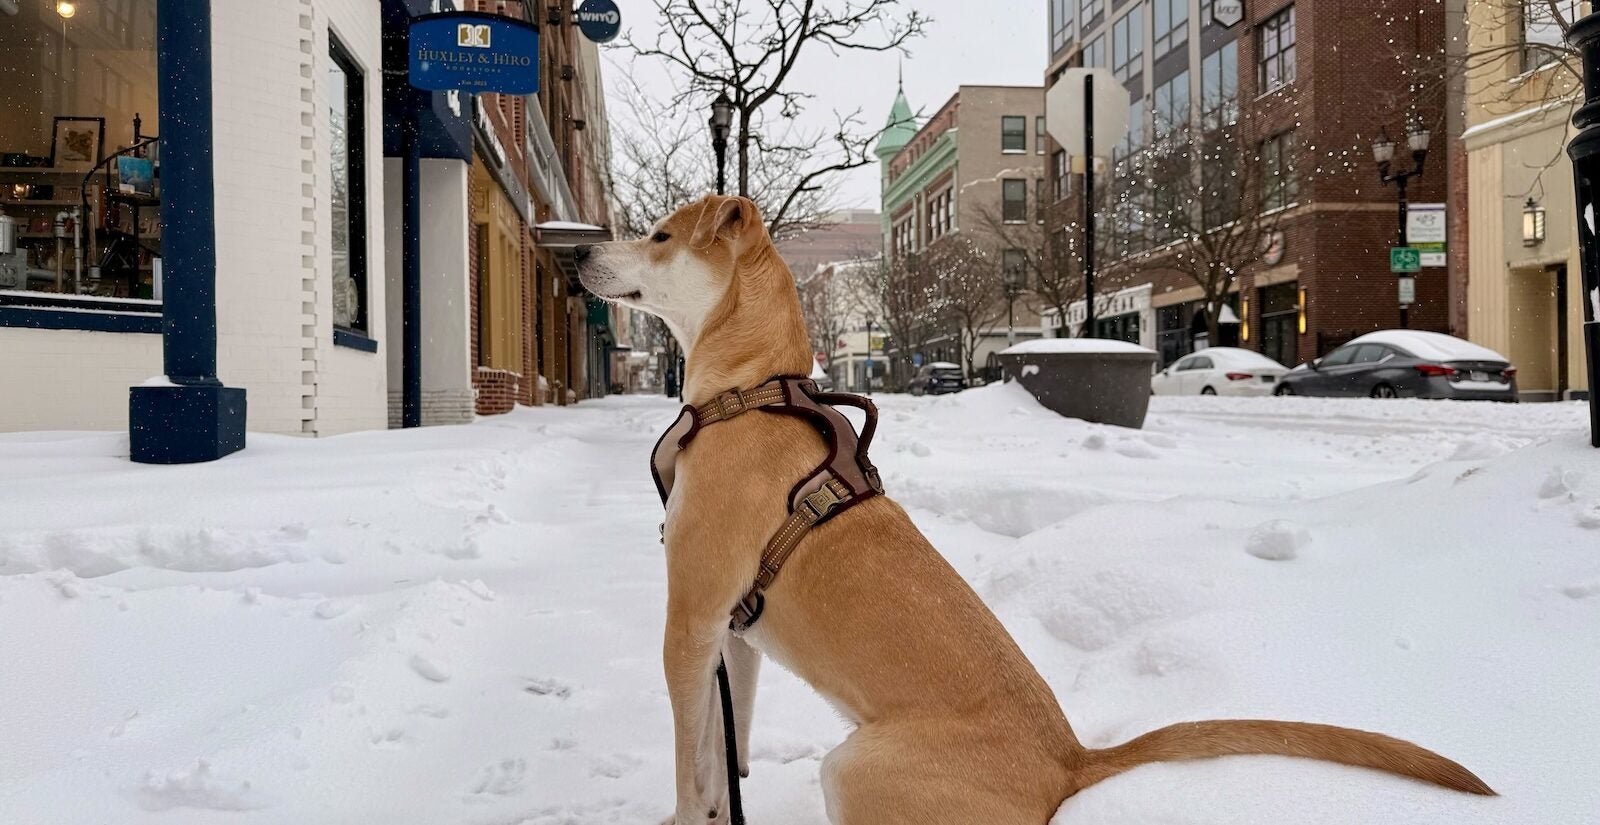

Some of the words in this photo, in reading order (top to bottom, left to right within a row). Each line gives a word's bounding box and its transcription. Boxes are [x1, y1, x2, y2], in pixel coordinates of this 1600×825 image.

[418, 49, 474, 64] HUXLEY
[477, 52, 489, 64] &
[493, 52, 531, 67] HIRO
